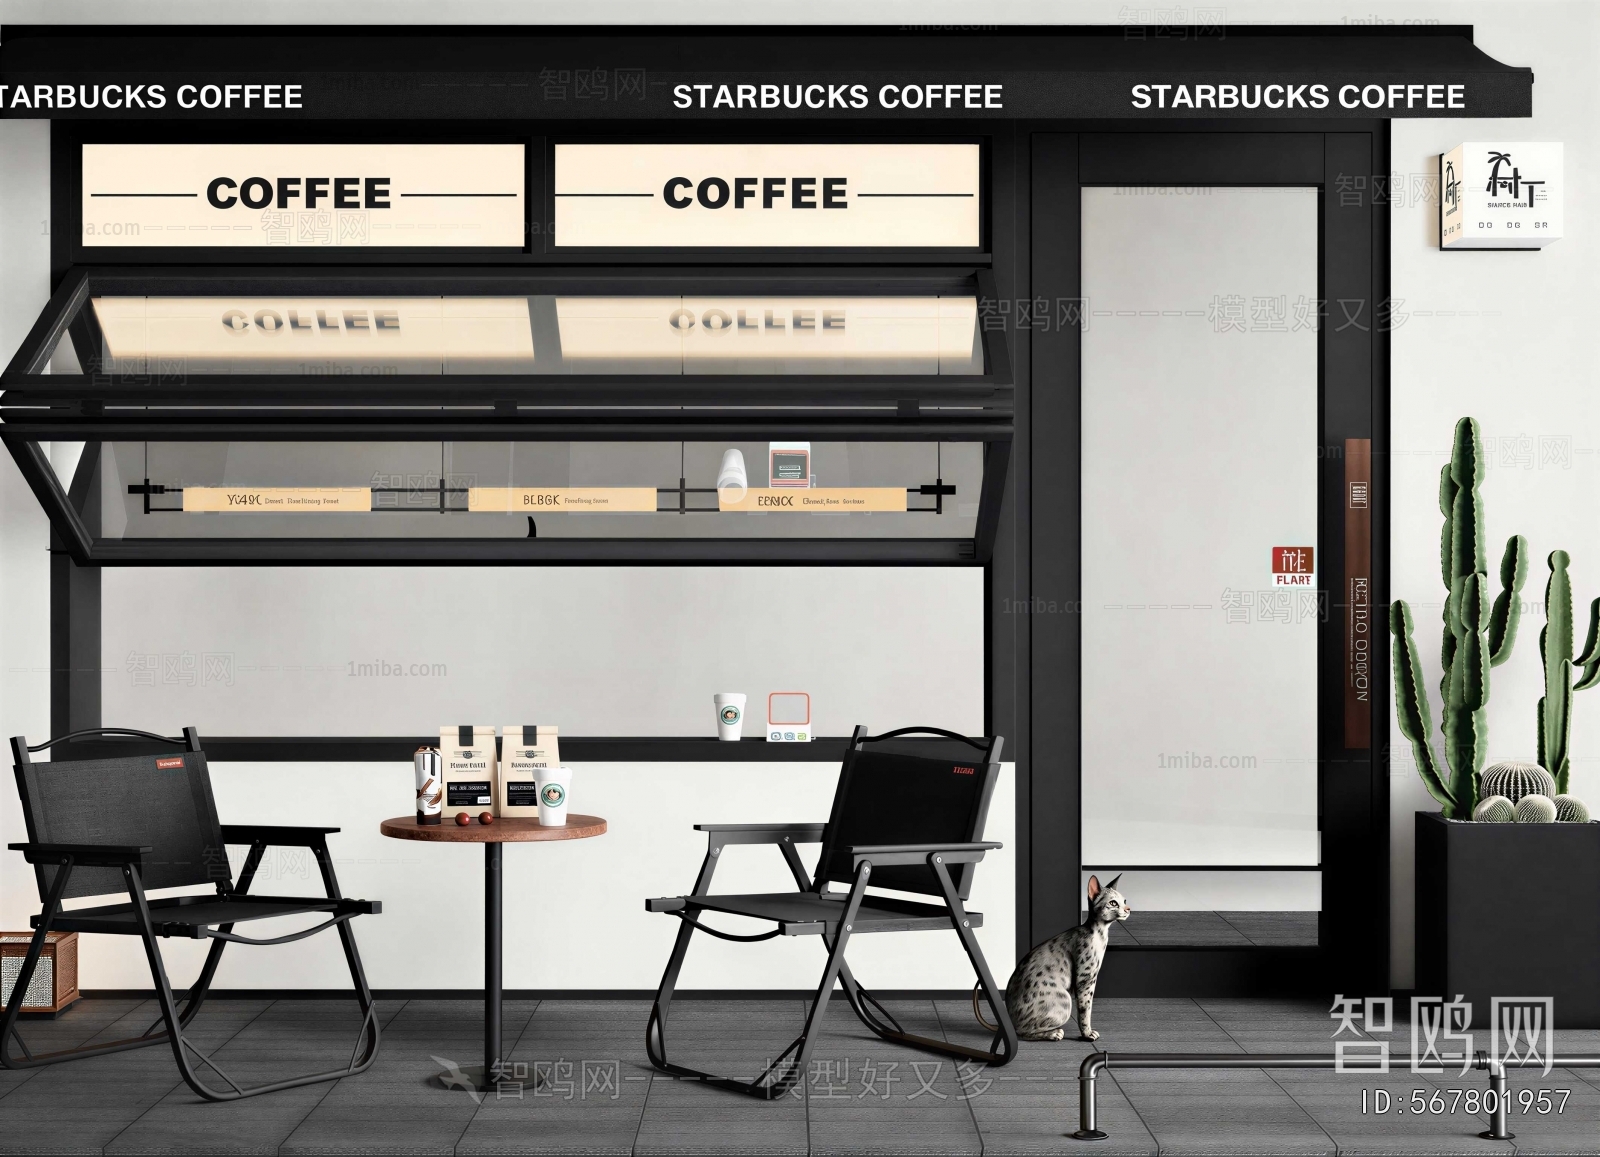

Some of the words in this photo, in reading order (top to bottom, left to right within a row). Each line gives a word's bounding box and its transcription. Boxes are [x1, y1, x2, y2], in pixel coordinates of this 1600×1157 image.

[176, 84, 303, 109] COFFEE
[672, 84, 869, 109] STARBUCKS
[878, 84, 1003, 109] COFFEE
[1131, 84, 1330, 109] STARBUCKS
[1338, 84, 1466, 109] COFFEE
[206, 176, 391, 210] COFFEE
[662, 176, 849, 210] COFFEE
